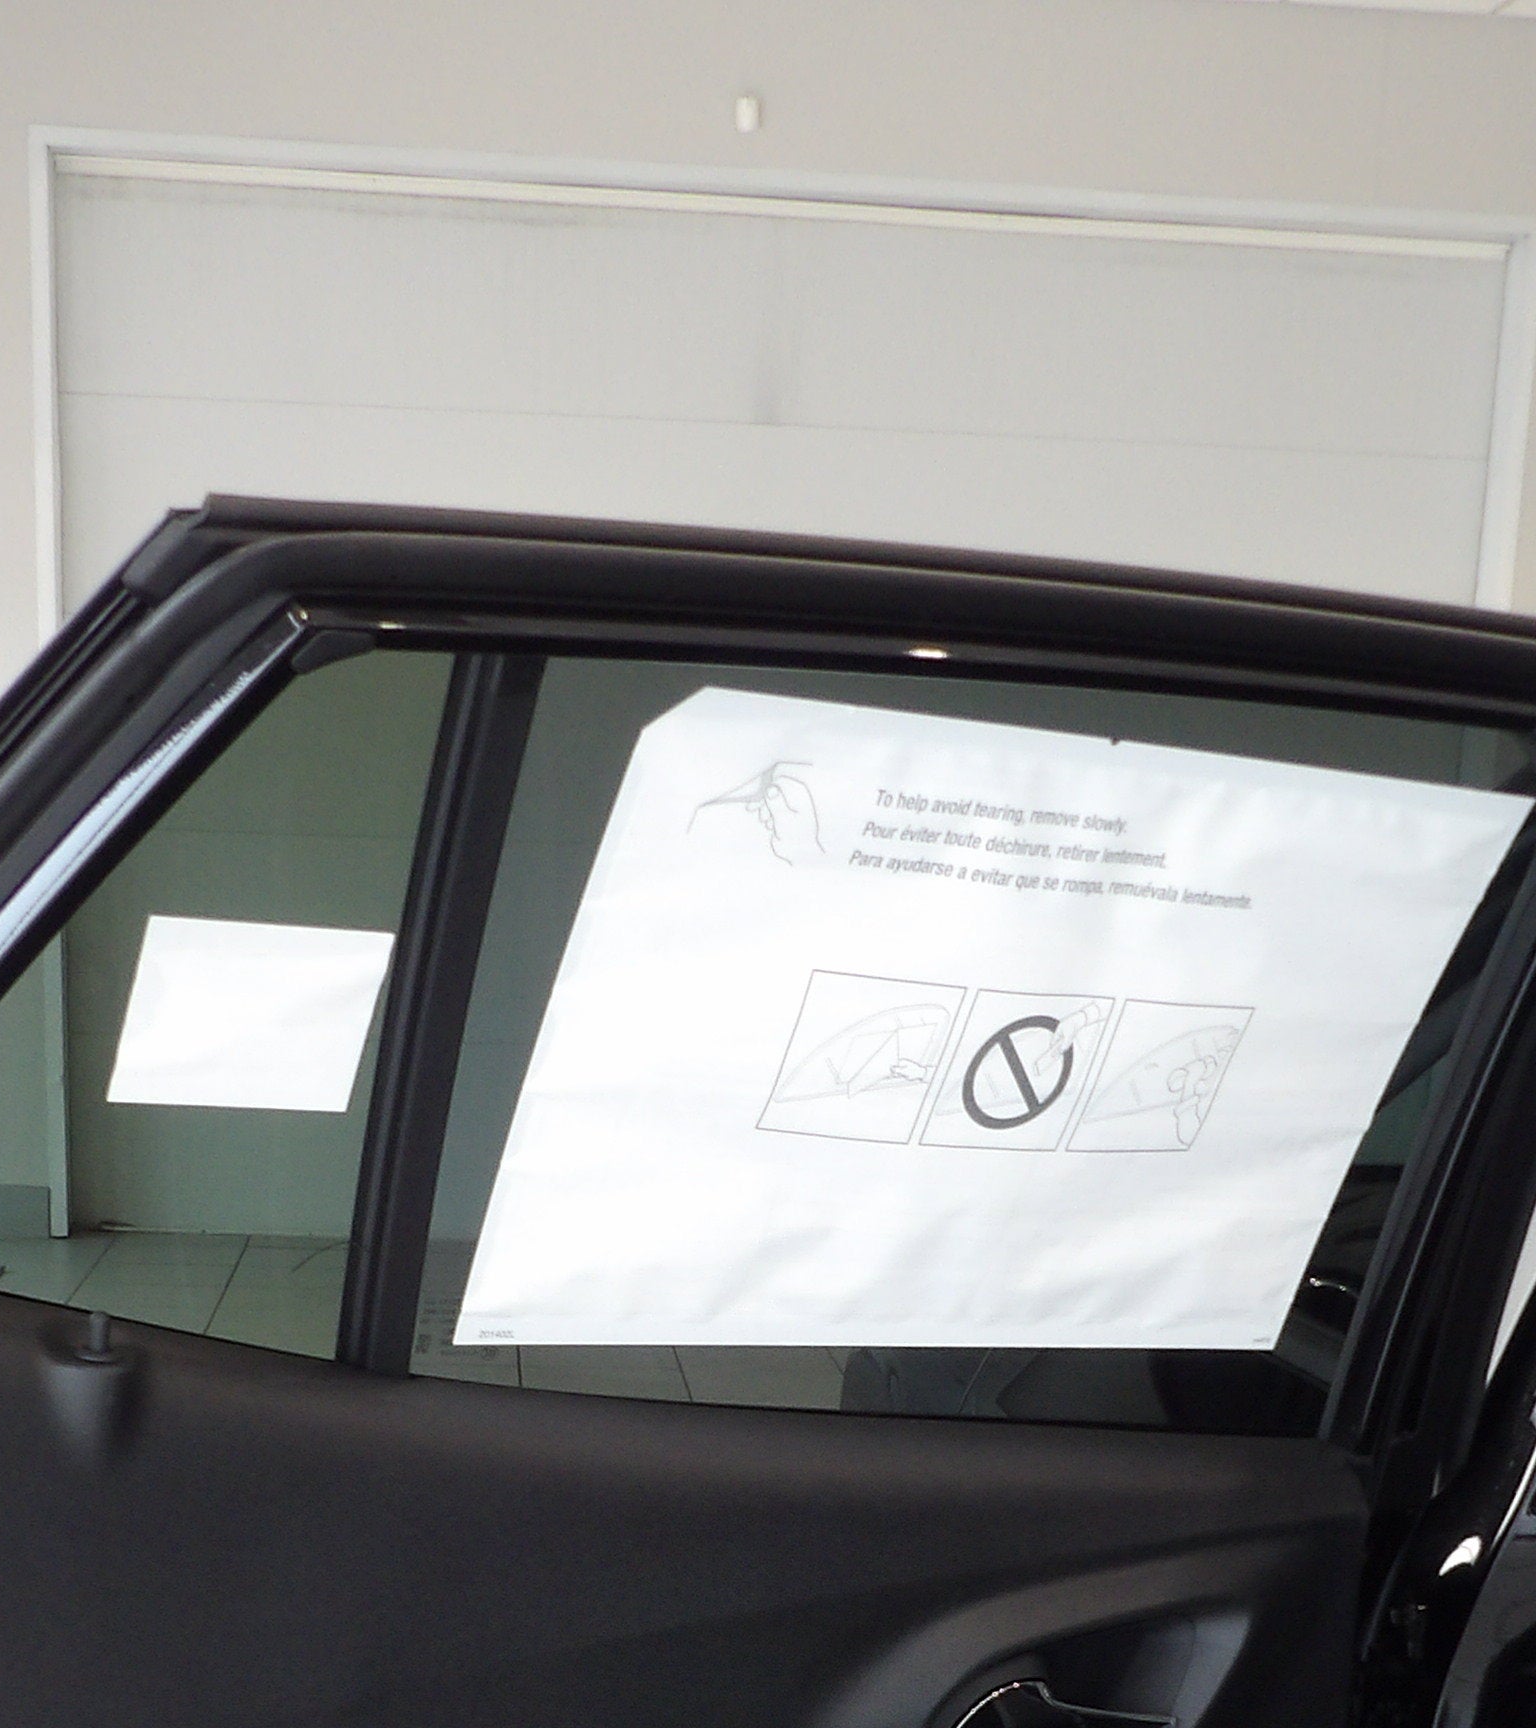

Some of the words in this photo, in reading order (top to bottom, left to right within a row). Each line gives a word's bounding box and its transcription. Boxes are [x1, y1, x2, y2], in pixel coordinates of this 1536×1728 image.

[876, 789, 893, 807] To
[896, 791, 928, 814] help
[931, 798, 973, 816] avoid
[1030, 810, 1079, 828] remove
[1082, 814, 1127, 836] slowly.
[862, 821, 897, 840] Pour
[900, 824, 941, 844] éviter
[943, 830, 982, 849] toute
[985, 836, 1052, 859] déchirure,
[1056, 844, 1100, 863] retirer
[848, 850, 883, 869] Para
[886, 857, 954, 877] ayudarse
[956, 866, 967, 880] a
[971, 868, 1014, 887] evitar
[1015, 874, 1040, 891] que
[1042, 877, 1059, 892] se
